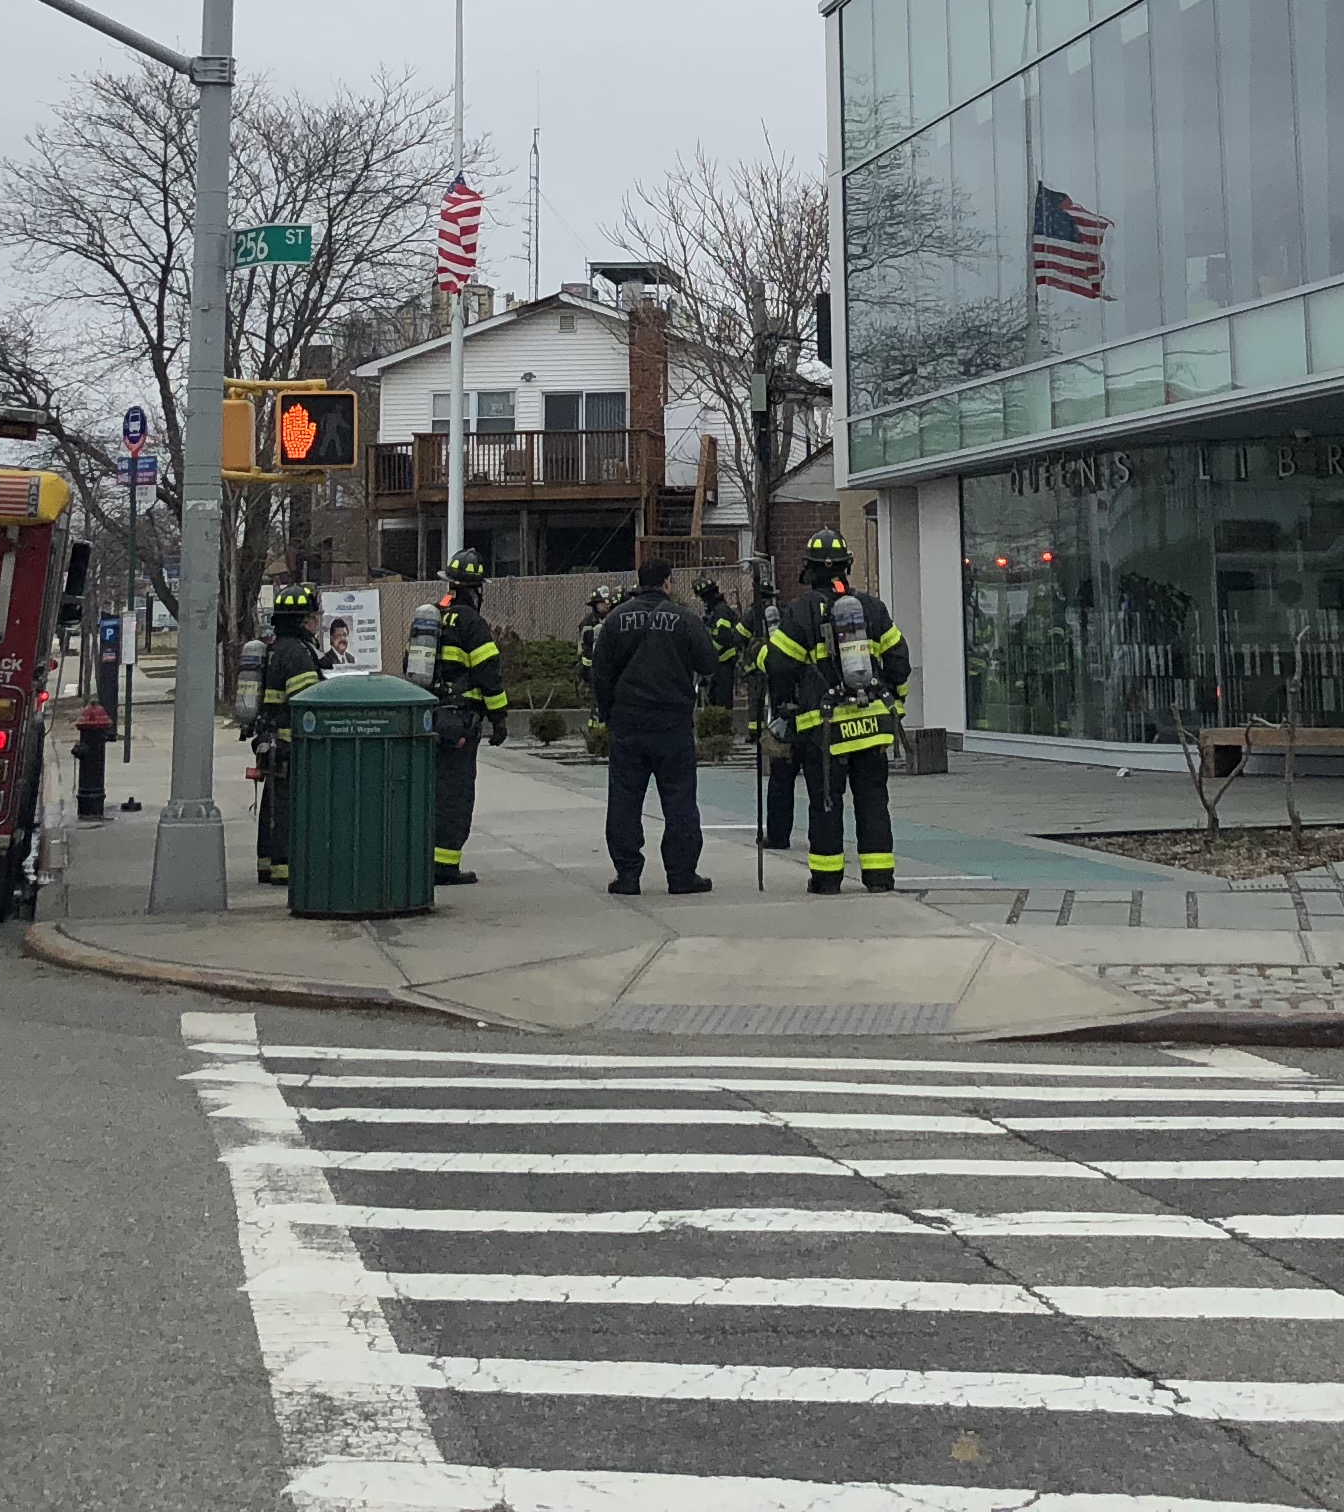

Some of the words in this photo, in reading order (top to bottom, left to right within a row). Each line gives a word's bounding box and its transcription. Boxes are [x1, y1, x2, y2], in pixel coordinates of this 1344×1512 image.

[236, 231, 269, 263] 256
[285, 229, 305, 245] ST
[1010, 451, 1130, 494] QUEENS
[28, 477, 40, 516] BACK
[106, 629, 114, 641] P
[619, 610, 680, 632] FDNY
[840, 716, 879, 739] ROACH
